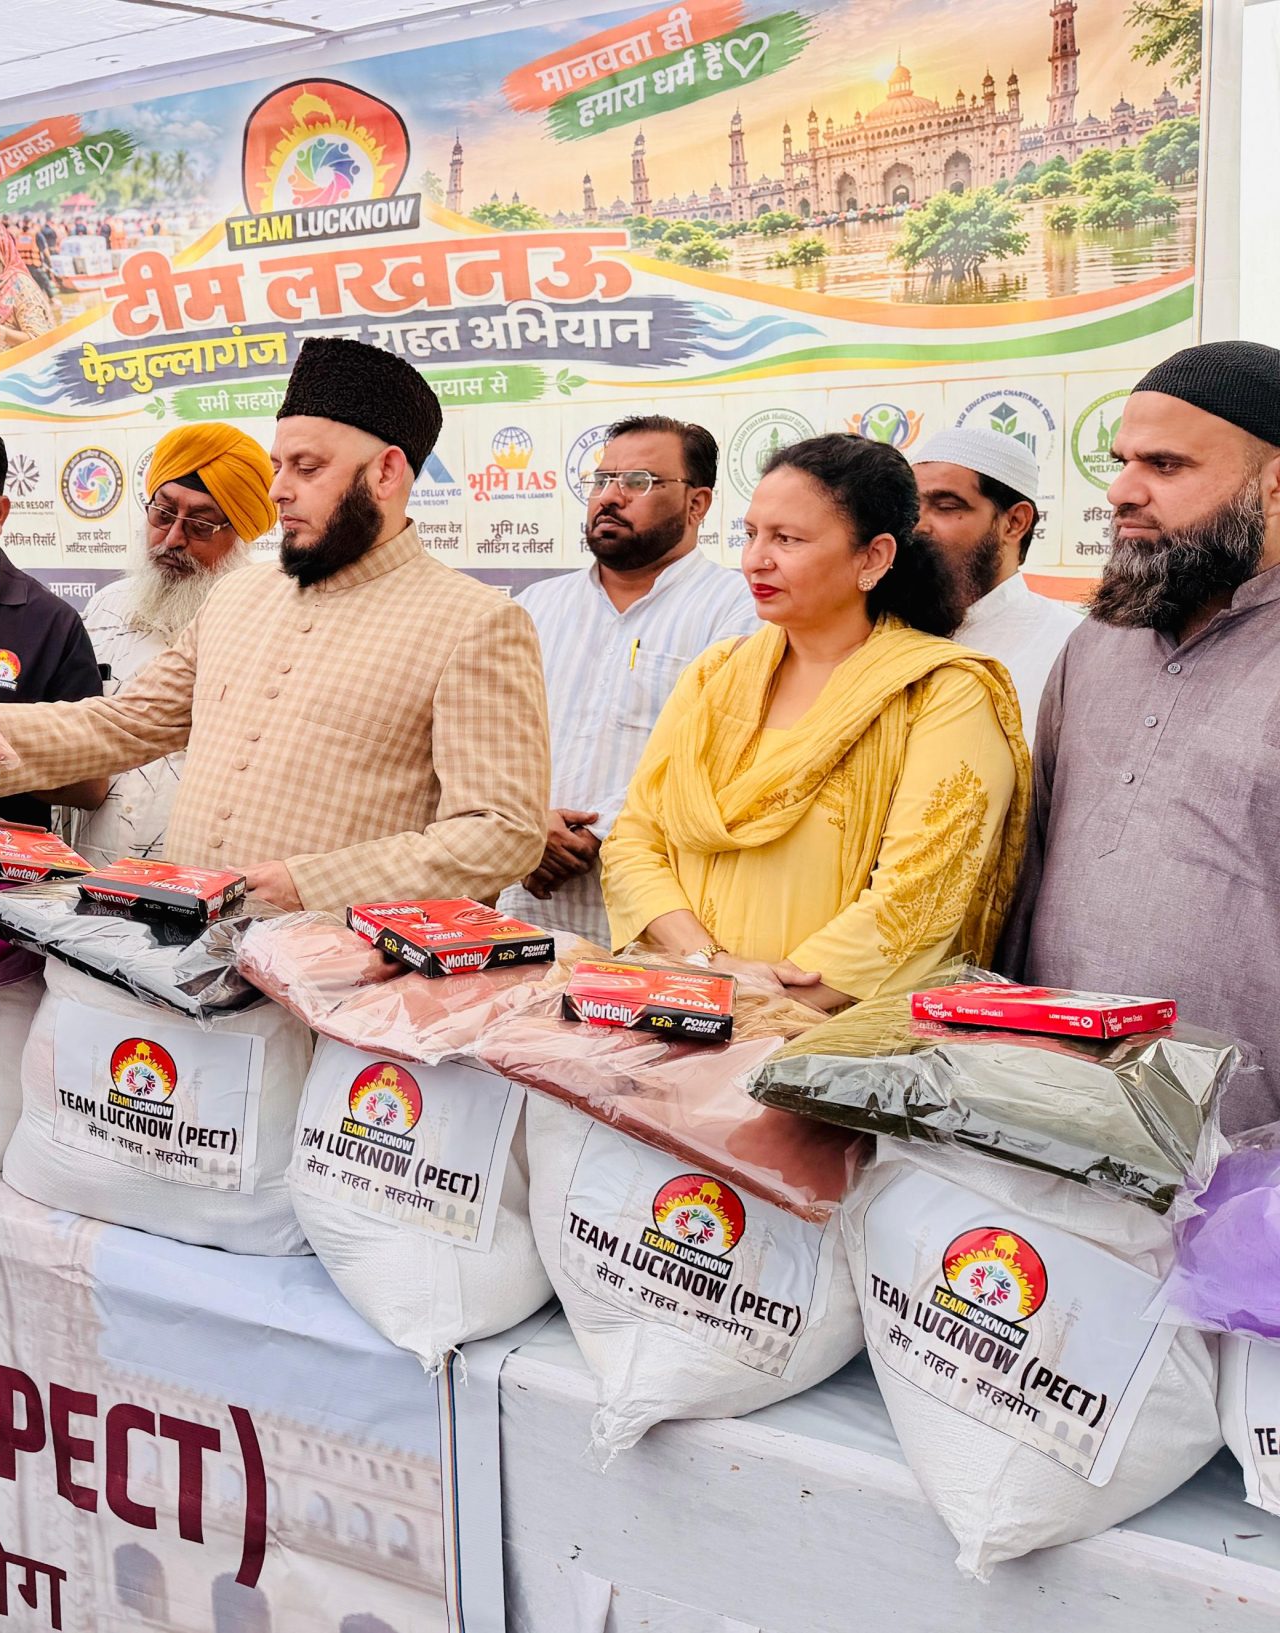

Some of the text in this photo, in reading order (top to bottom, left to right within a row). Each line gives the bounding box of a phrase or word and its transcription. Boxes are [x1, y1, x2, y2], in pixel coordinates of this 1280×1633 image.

[536, 8, 695, 91] मानवता ही
[577, 76, 646, 128] हमारा
[653, 49, 696, 94] धर्म
[7, 173, 32, 204] हम
[35, 156, 69, 190] साथ
[104, 231, 632, 337] टीम लखनऊ
[468, 300, 653, 350] अभियान
[197, 389, 230, 412] सभी
[488, 371, 508, 394] से
[447, 488, 462, 496] VEG
[467, 464, 557, 502] भूमि IAS
[26, 501, 54, 509] RESORT
[491, 520, 539, 539] भूमि IAS
[7, 866, 39, 882] Mortein
[94, 892, 130, 906] Mortein
[353, 915, 379, 939] Mortein
[401, 944, 426, 961] POWER
[446, 951, 483, 968] Mortein
[521, 943, 551, 955] POWER
[581, 1000, 633, 1023] Mortein
[682, 1017, 722, 1030] POWER
[685, 1025, 716, 1034] BOOSTER
[956, 1006, 1004, 1017] Green Shakti
[59, 1089, 237, 1155] TEAM LUCKNOW (PECT)
[87, 1123, 198, 1168] सेवा राहत सहयोग
[306, 1155, 435, 1212] सेवा राहत सहयोग
[326, 1137, 412, 1179] LUCKNOW
[414, 1158, 480, 1203] (PECT)
[570, 1212, 802, 1337] TEAM LUCKNOW (PECT)
[596, 1261, 754, 1342] सेवा राहत सहयोग
[871, 1274, 1109, 1429] TEAM LUCKNOW (PECT)
[888, 1324, 1041, 1423] सेवा राहत सहयोग
[1254, 1427, 1280, 1456] TE
